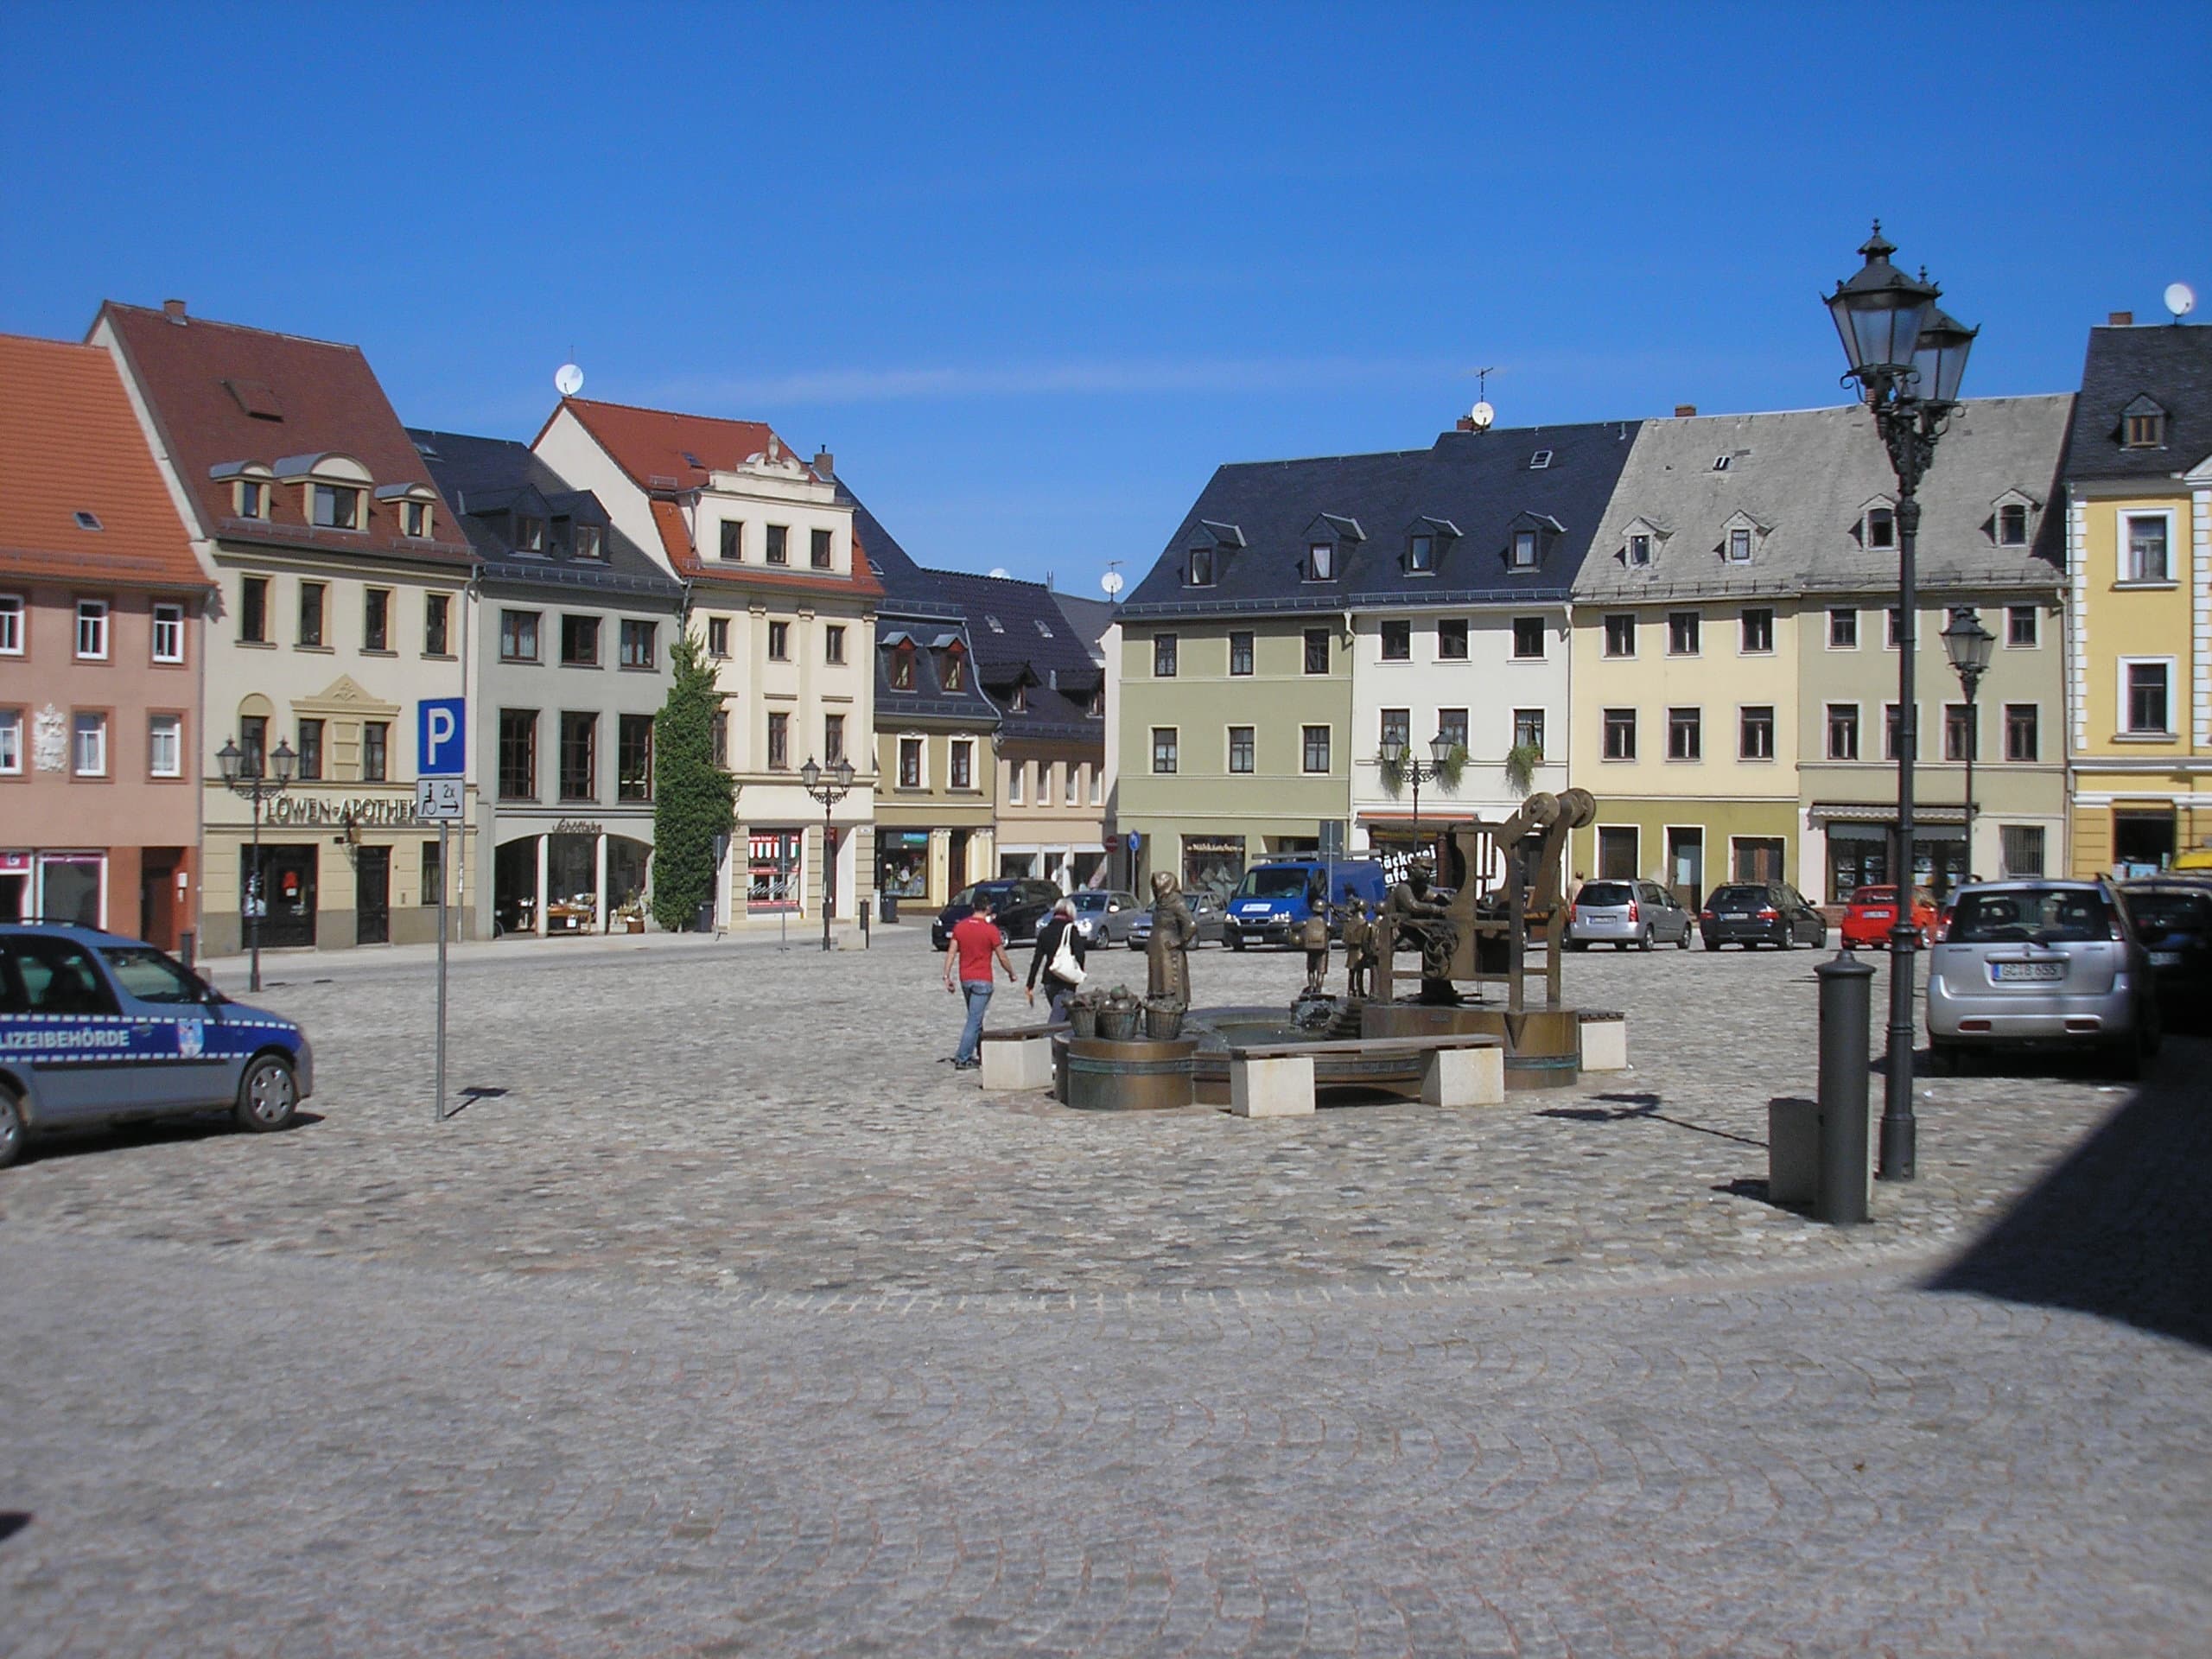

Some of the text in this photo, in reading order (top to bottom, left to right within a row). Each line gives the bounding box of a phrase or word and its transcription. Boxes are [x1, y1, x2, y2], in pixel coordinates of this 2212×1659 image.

[429, 708, 455, 766] P
[443, 784, 455, 798] 2x
[266, 795, 418, 821] LÖWEN-APOTHEK
[1374, 843, 1436, 869] äckerei
[1384, 867, 1408, 884] afé
